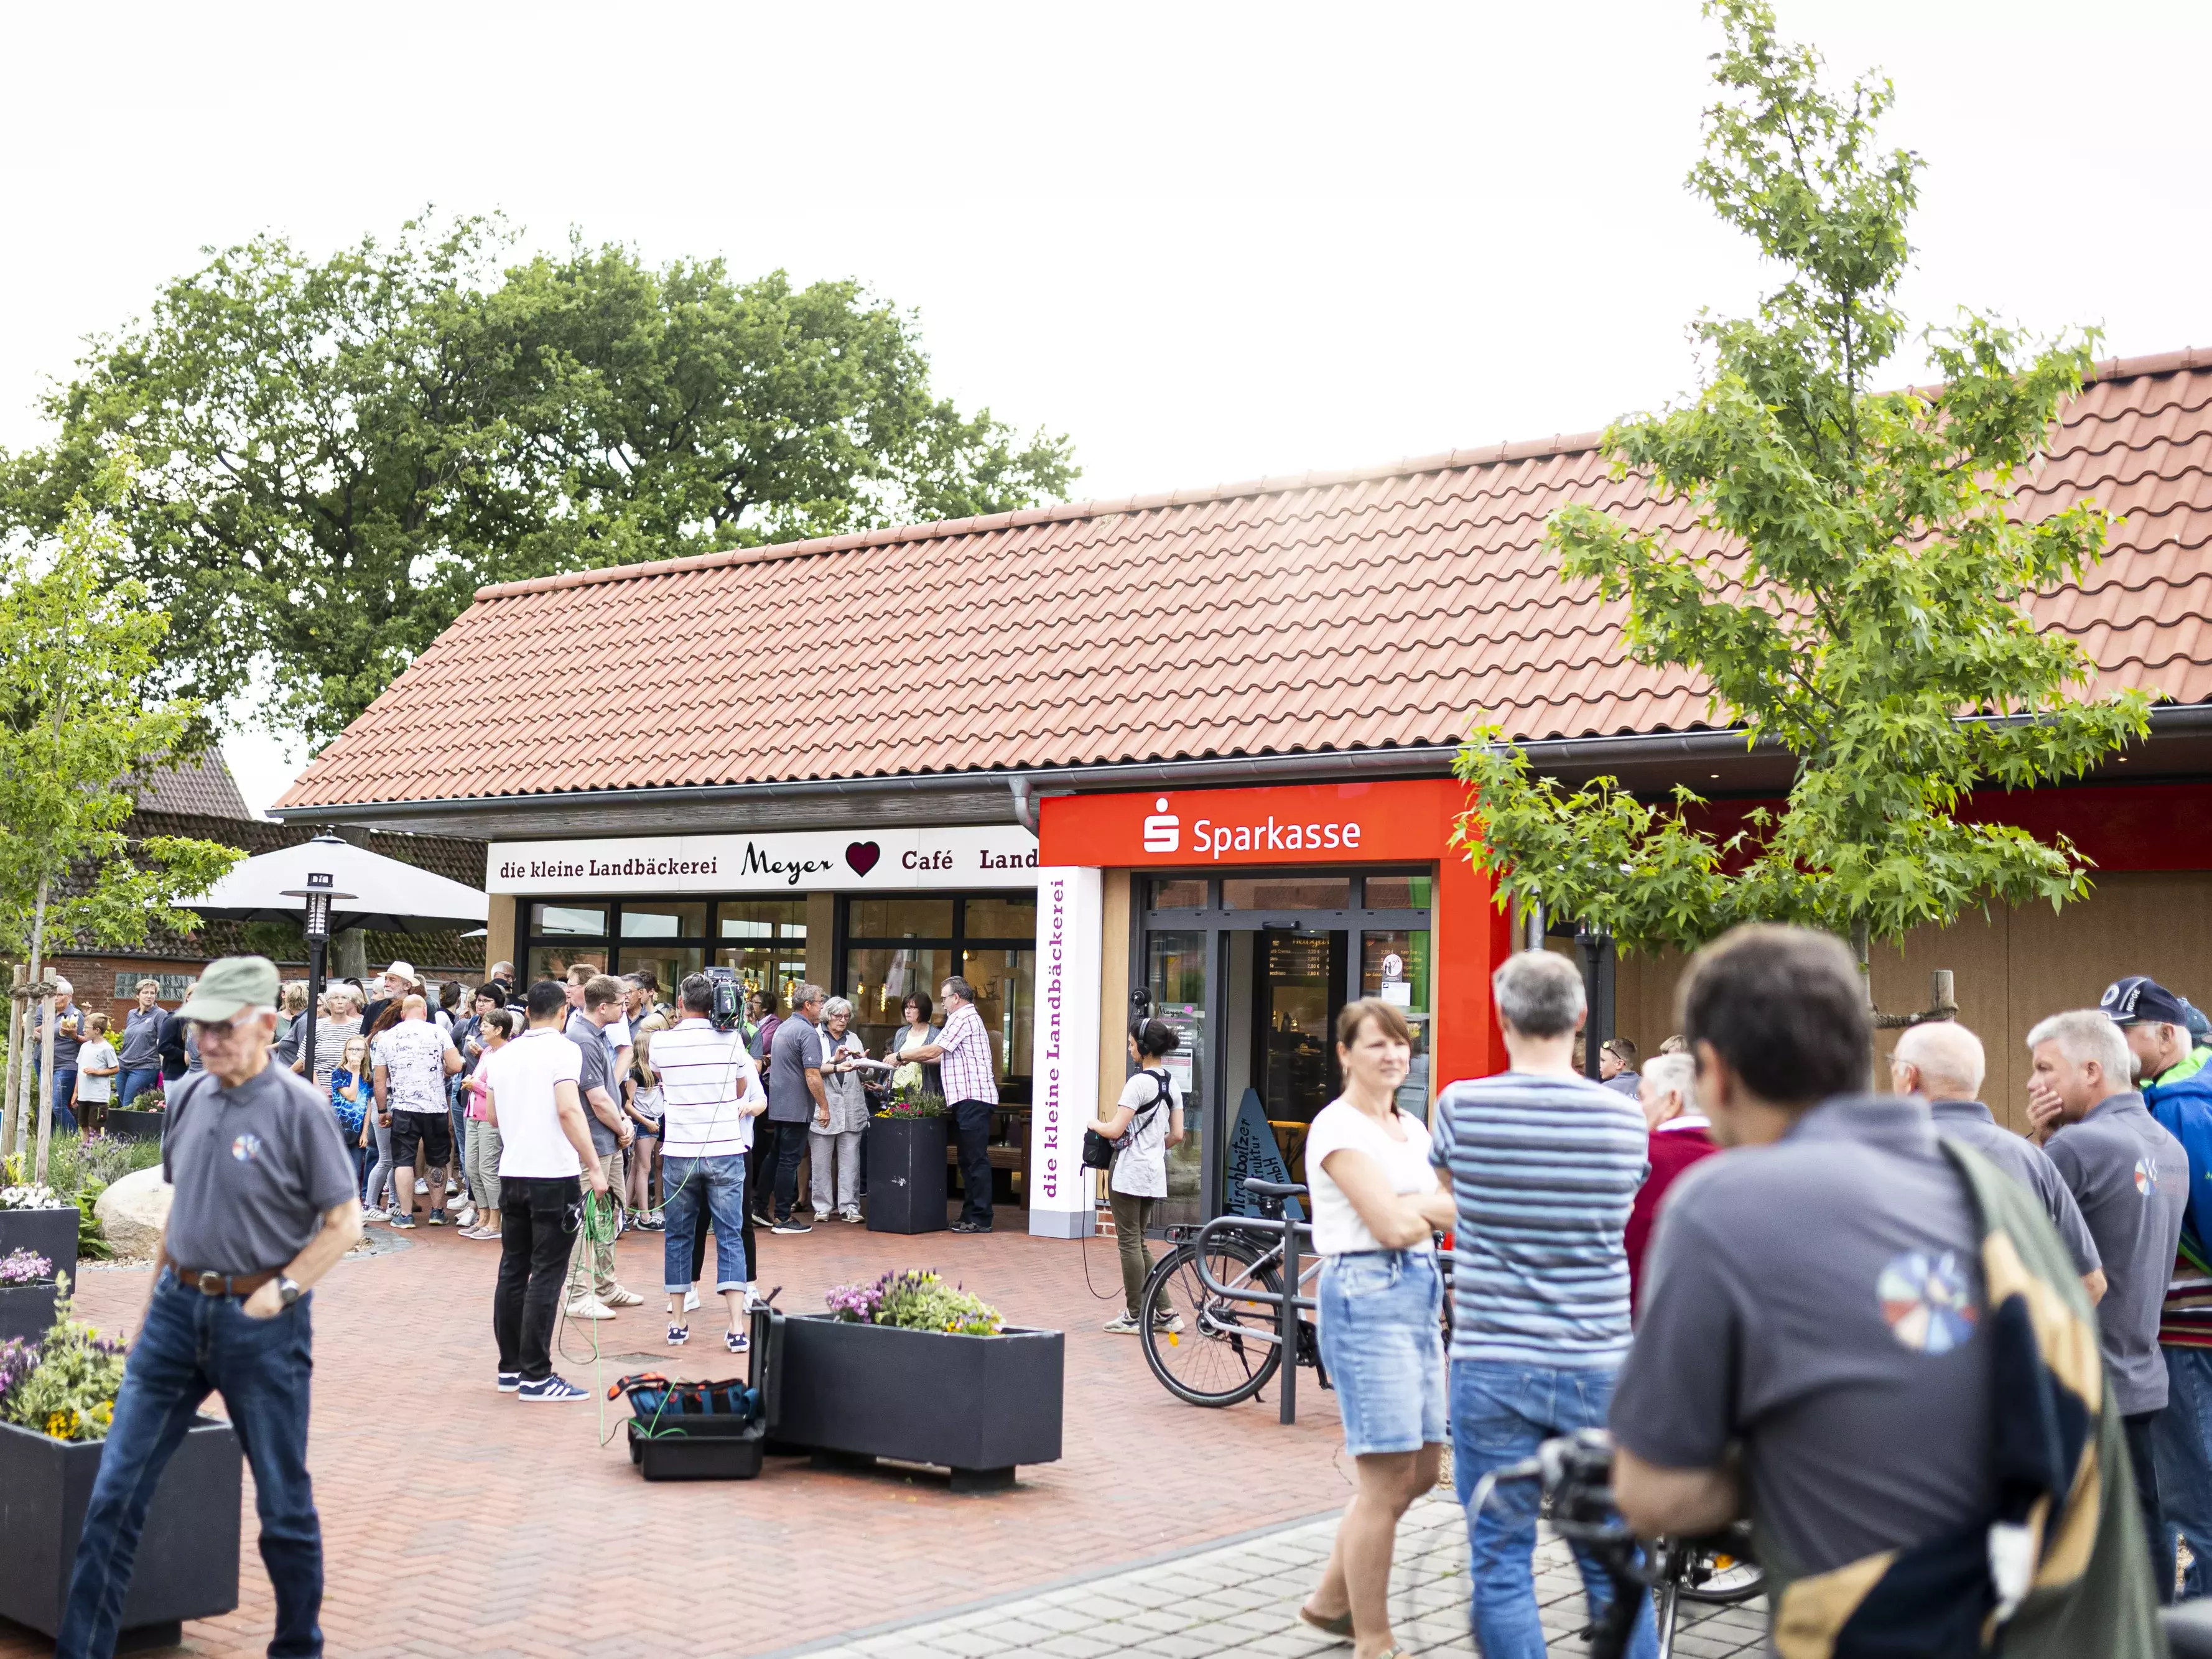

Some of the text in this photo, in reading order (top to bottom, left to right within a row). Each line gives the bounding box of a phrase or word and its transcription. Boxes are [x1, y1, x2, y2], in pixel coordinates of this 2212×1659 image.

[1194, 816, 1360, 859] Sparkasse
[501, 841, 1039, 885] die kleine Landbäckerei Meyer Café Land
[725, 998, 732, 1010] 1
[2126, 989, 2141, 1013] NORGE
[1044, 880, 1064, 1198] die kleine Landbäckerei
